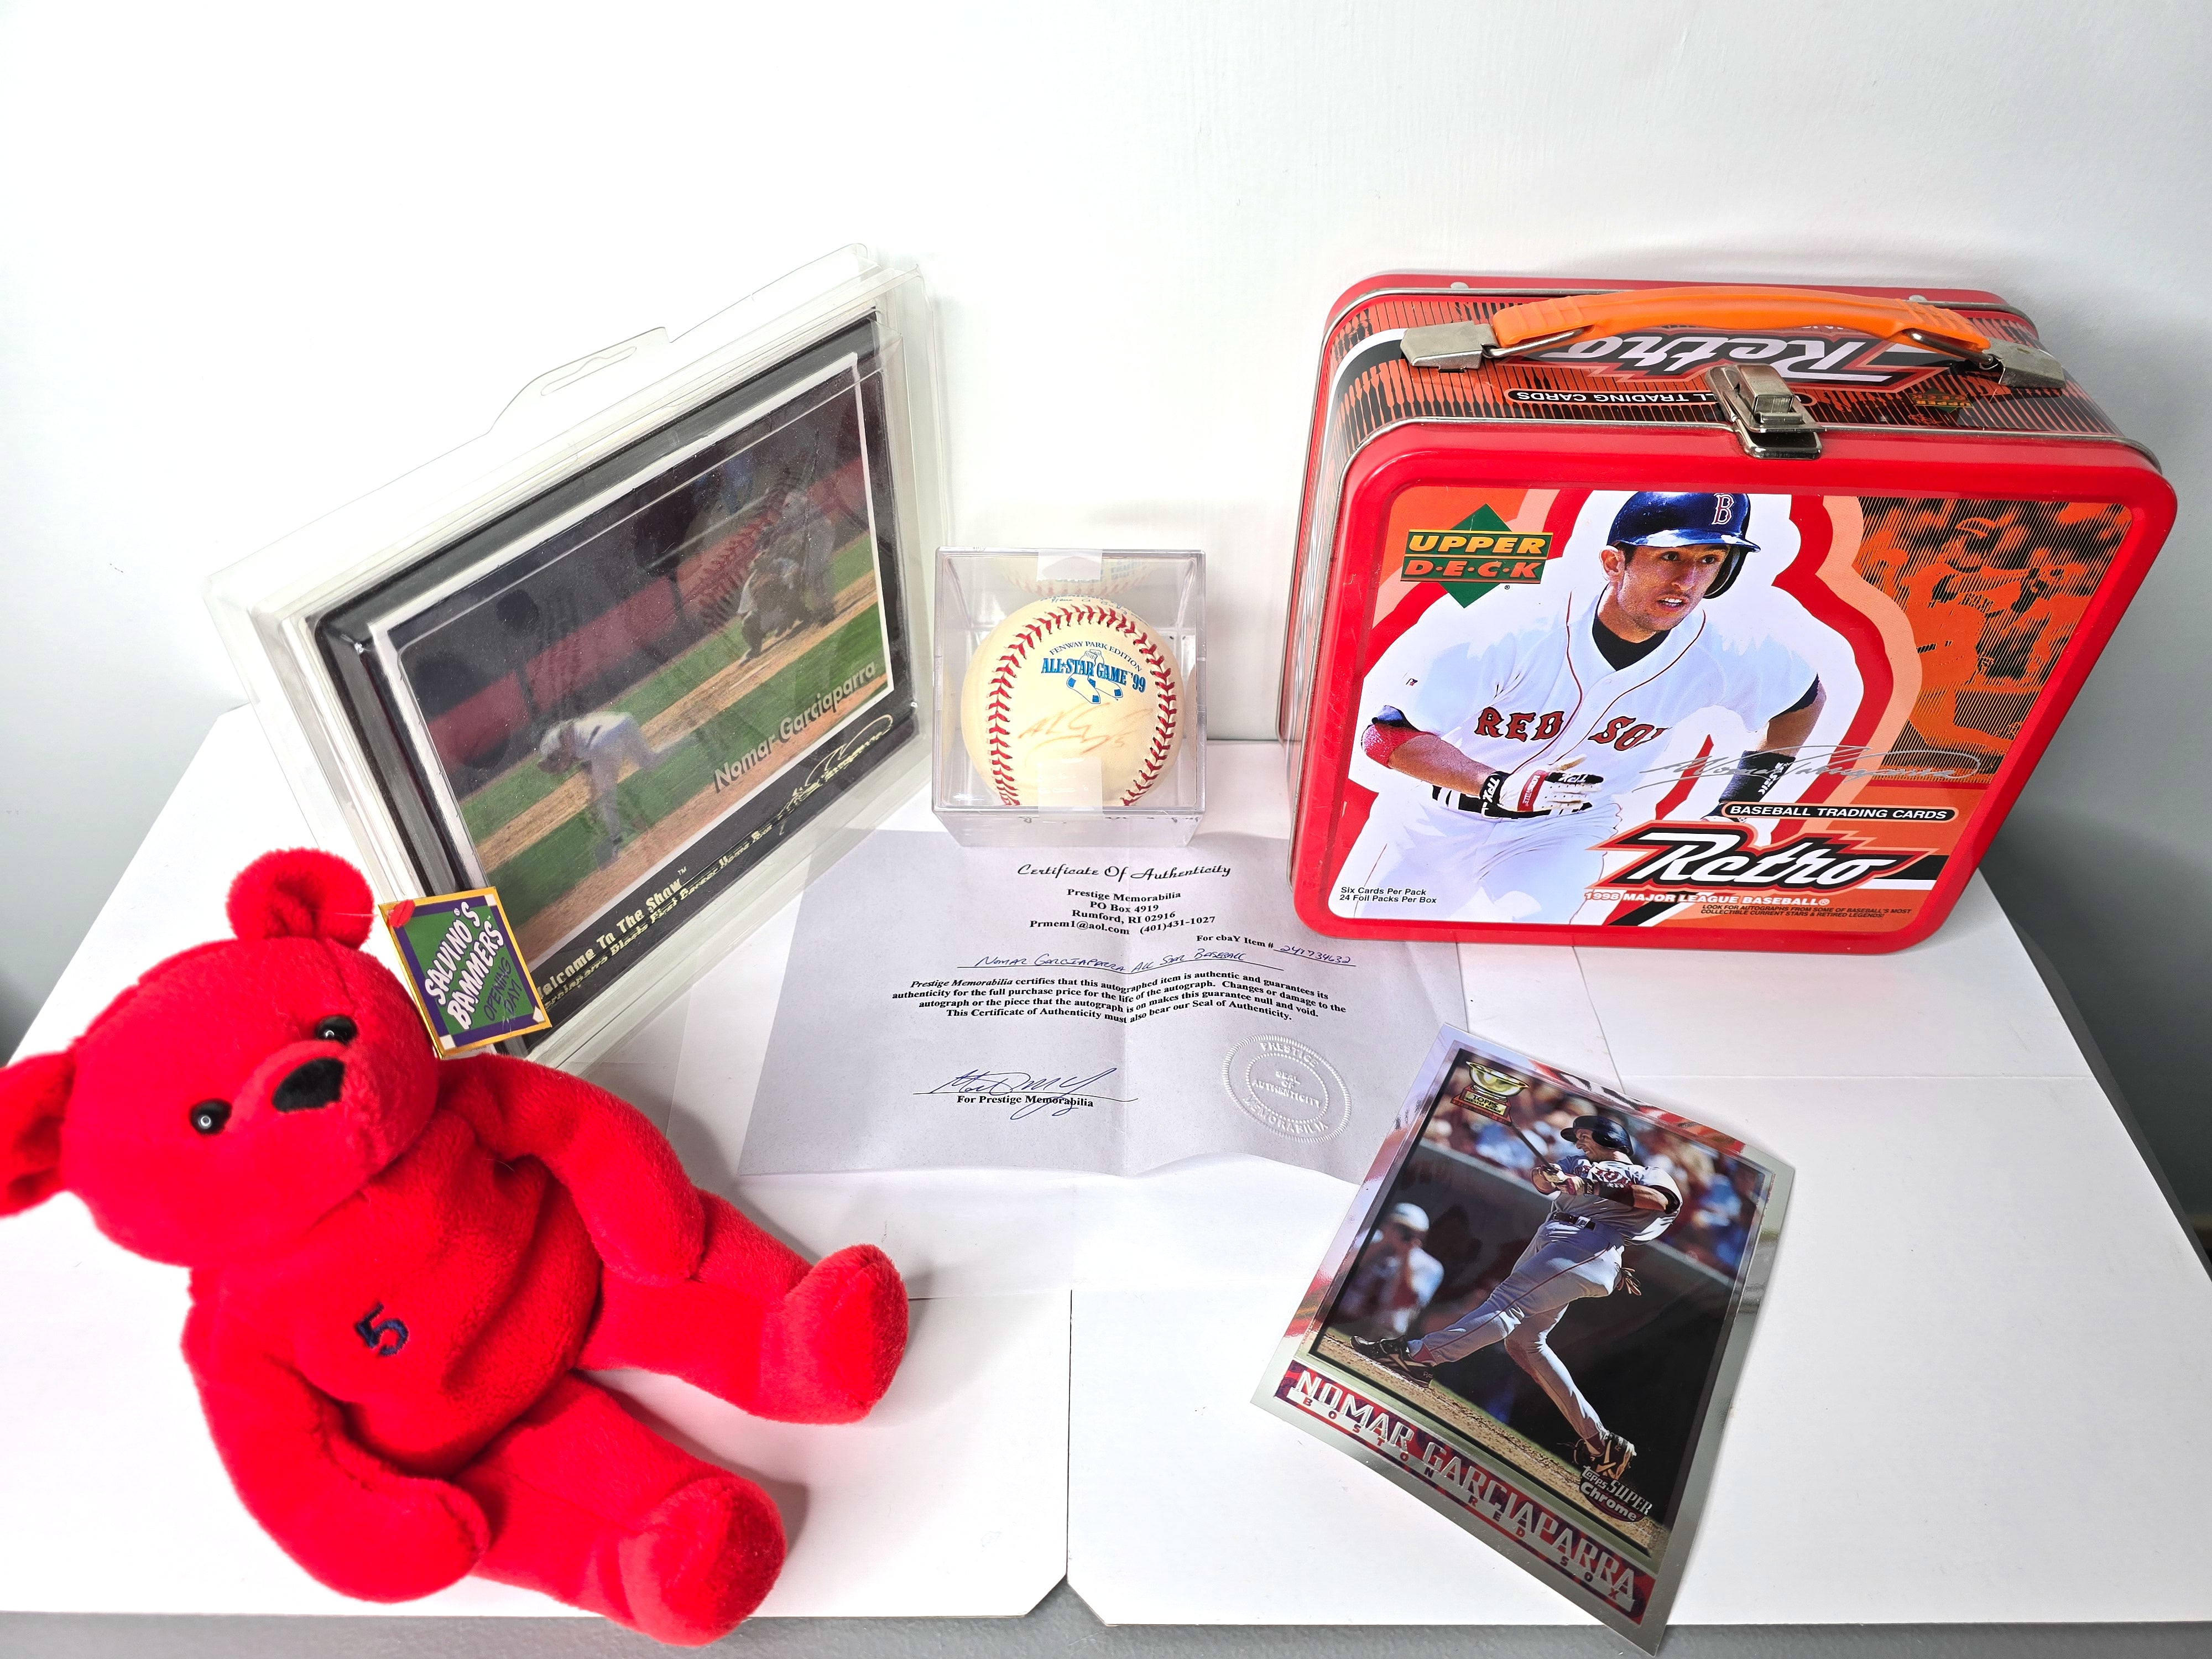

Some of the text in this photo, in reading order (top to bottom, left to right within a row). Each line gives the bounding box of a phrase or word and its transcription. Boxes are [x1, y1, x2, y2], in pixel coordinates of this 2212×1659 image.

[1540, 336, 1892, 382] Retro
[1517, 392, 1587, 401] CARDS
[1594, 392, 1689, 402] TRADING
[1712, 493, 1735, 525] B
[1409, 535, 1546, 554] UPPER
[1050, 641, 1142, 672] FENWAY PARK EDITION
[1097, 662, 1128, 686] GAME
[714, 734, 775, 792] Nomar
[780, 661, 876, 743] Garciaparra
[1474, 707, 1564, 742] RED
[1730, 806, 1947, 820] BASEBALL TRADING CARDS
[1627, 832, 1891, 885] Retro
[1018, 864, 1232, 882] Certificate Of Authenticity
[1067, 888, 1181, 902] Prestige Memorabilia
[1090, 901, 1159, 913] PO Box 4919
[1584, 892, 1620, 901] 1998
[1623, 893, 1676, 902] MAJOR
[1678, 895, 1739, 904] LEAGUE
[597, 932, 616, 950] To
[617, 908, 645, 934] The
[1030, 915, 1216, 935] Prmem1@aol.com (401)431-1027
[1072, 910, 1176, 924] Rumford, RI 02916
[1244, 937, 1266, 947] Item
[447, 920, 504, 1030] BAMMERS
[483, 957, 512, 1021] OPENING
[1080, 979, 1098, 987] this
[1100, 979, 1158, 994] autographed
[1161, 975, 1181, 984] item
[1194, 971, 1240, 979] authentic
[1243, 974, 1261, 984] and
[1263, 979, 1315, 997] guarantees
[1317, 990, 1329, 1000] its
[892, 989, 950, 999] authenticity
[1008, 988, 1053, 997] purchase
[1056, 988, 1082, 997] price
[1101, 992, 1117, 1000] the
[1118, 995, 1134, 1004] life
[1146, 988, 1161, 998] the
[1164, 980, 1216, 993] autograph.
[1222, 980, 1264, 993] Changes
[1279, 992, 1317, 1007] damage
[1330, 1004, 1347, 1013] the
[919, 999, 969, 1008] autograph
[1004, 998, 1030, 1007] piece
[1074, 1000, 1124, 1013] autograph
[1126, 1005, 1134, 1014] is
[1149, 995, 1179, 1006] makes
[1181, 991, 1199, 999] this
[1202, 990, 1252, 1001] guarantee
[1254, 997, 1273, 1005] null
[1275, 1000, 1293, 1011] and
[1296, 1005, 1319, 1018] void.
[971, 1008, 1025, 1016] Certificate
[1040, 1008, 1102, 1019] Authenticity
[1104, 1014, 1127, 1024] must
[1130, 1012, 1147, 1023] also
[1149, 1006, 1171, 1016] bear
[1173, 1003, 1191, 1011] our
[1192, 999, 1213, 1008] Seal
[1228, 1000, 1292, 1020] Authenticity.
[957, 1094, 1094, 1108] For Prestige Memorabilia
[1251, 1079, 1321, 1108] AUTHENTICITY
[1472, 1094, 1499, 1109] TOPPS
[355, 1302, 409, 1356] 5
[1296, 1370, 1637, 1601] NOMAR GARCIAPARRA
[1606, 1479, 1652, 1515] SUPER
[1580, 1481, 1637, 1521] Chrome
